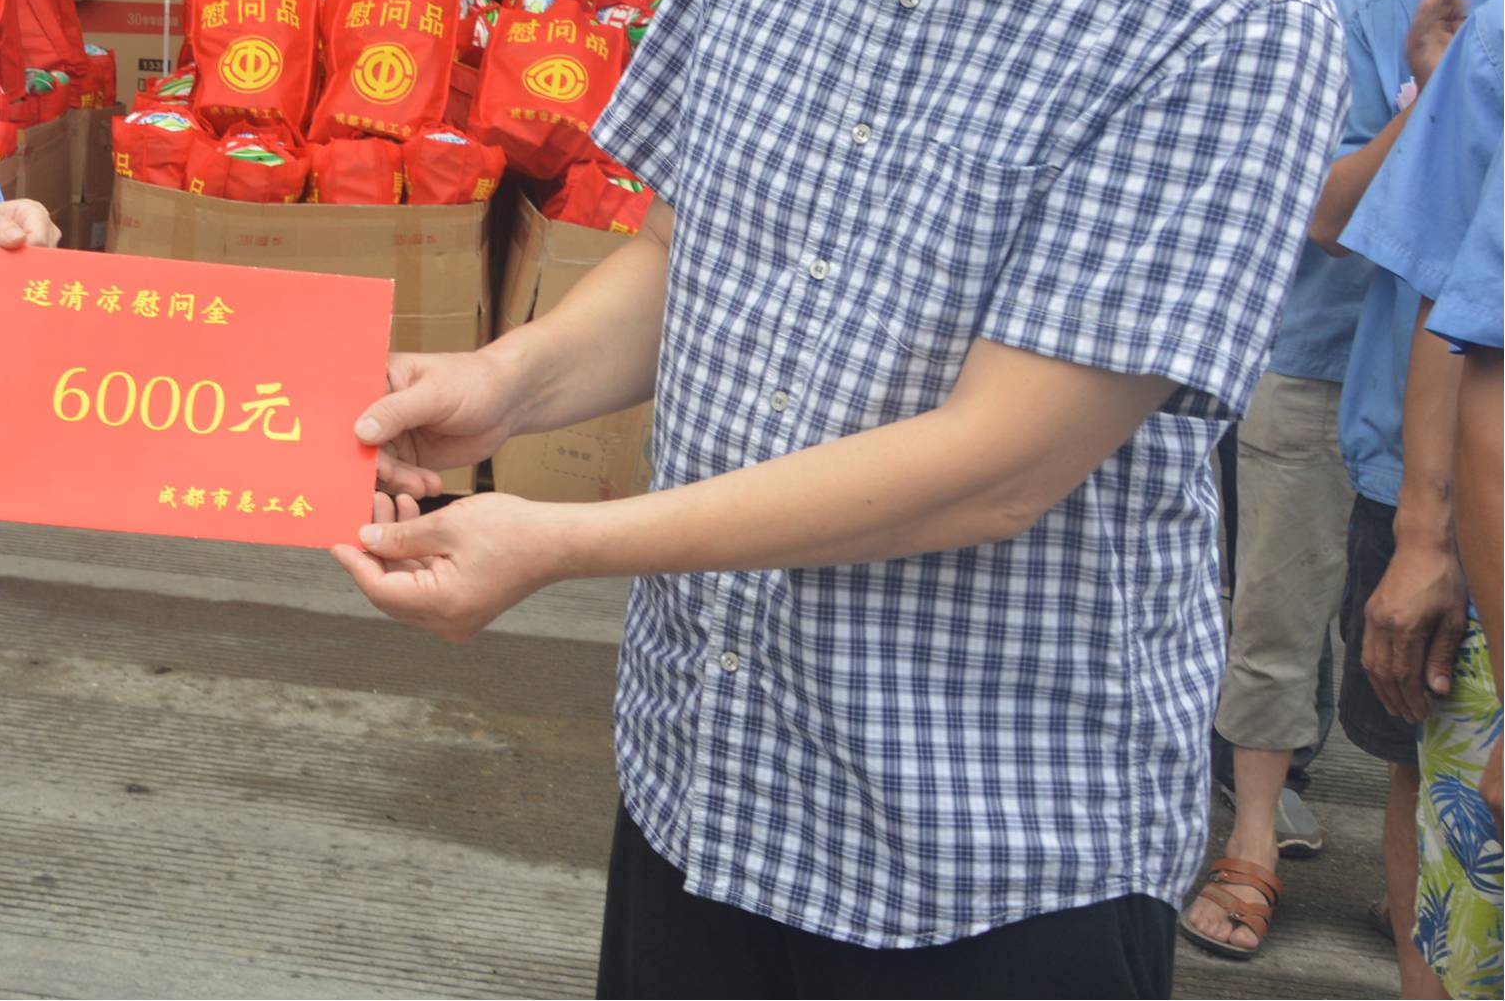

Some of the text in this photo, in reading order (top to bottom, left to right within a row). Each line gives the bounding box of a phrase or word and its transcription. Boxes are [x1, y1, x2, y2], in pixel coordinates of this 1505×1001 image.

[507, 18, 610, 62] 慰问品
[22, 279, 235, 326] 送清凉慰问金
[52, 366, 302, 442] 6000元
[159, 485, 314, 518] 成都市总工会
